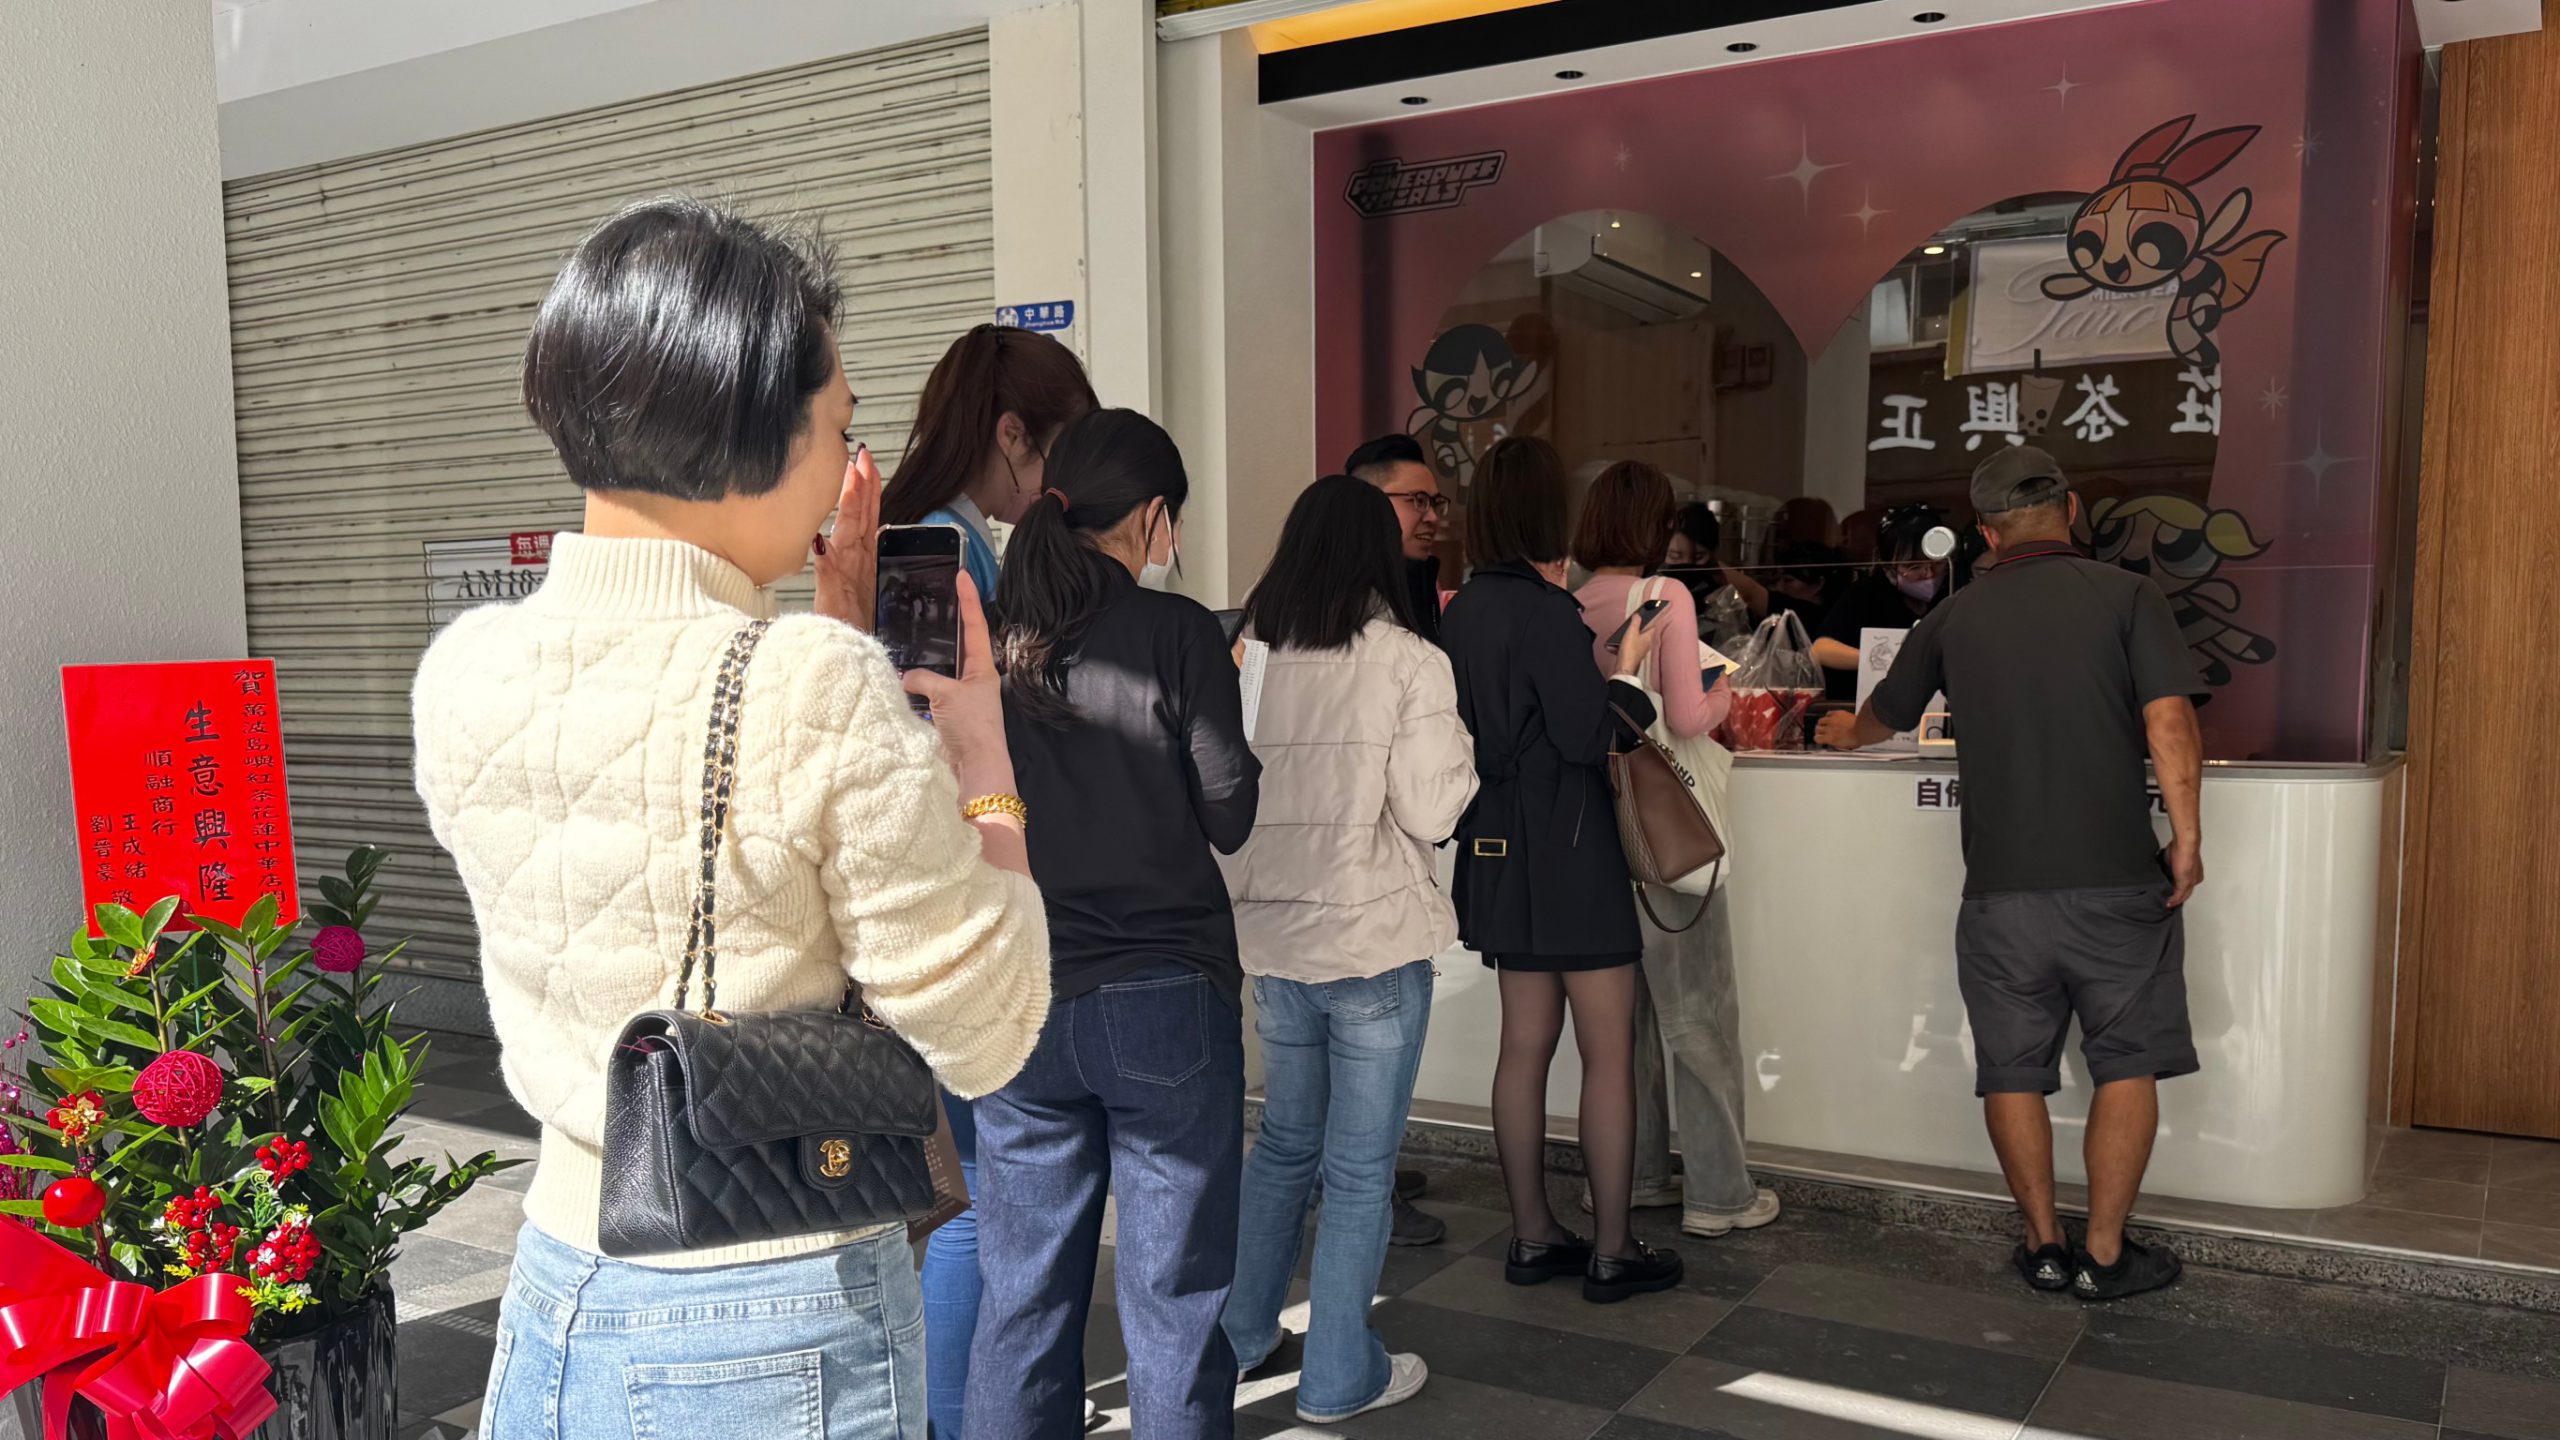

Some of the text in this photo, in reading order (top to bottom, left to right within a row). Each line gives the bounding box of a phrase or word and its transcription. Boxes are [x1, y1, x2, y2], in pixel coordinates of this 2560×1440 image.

[1351, 158, 1498, 196] POWERPUFF
[1973, 255, 2160, 356] Taro
[233, 669, 267, 697] 賀
[144, 749, 180, 837] 順融商行
[184, 700, 235, 904] 生意興隆
[90, 815, 117, 883] 劉晉豪
[120, 813, 147, 879] 王成緒
